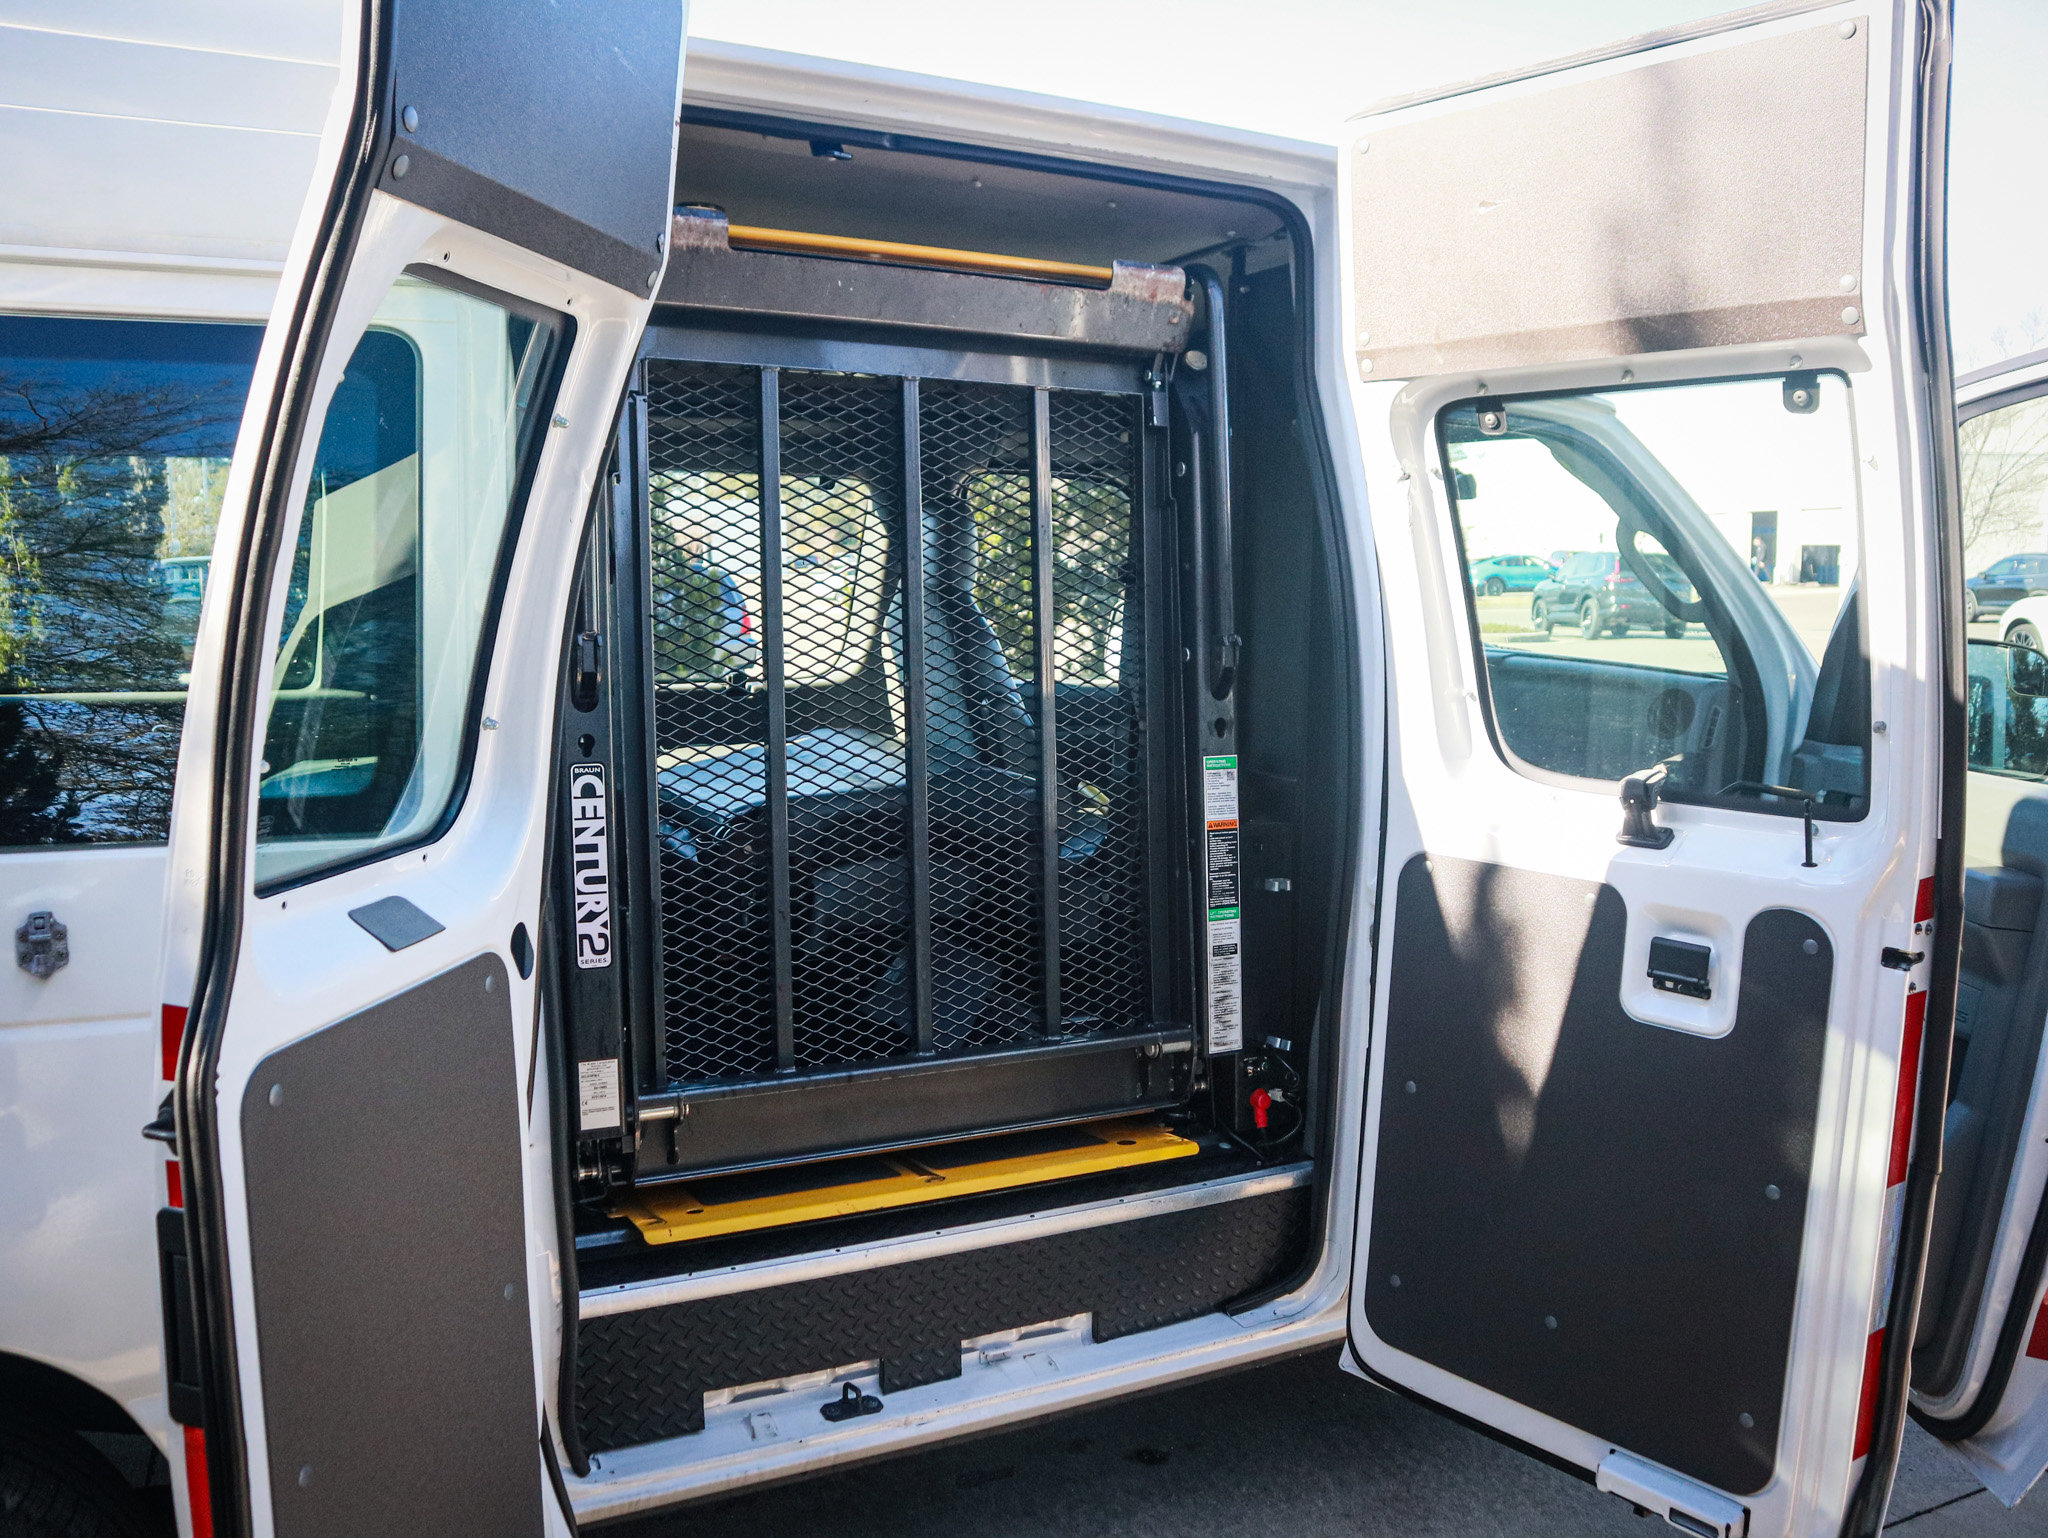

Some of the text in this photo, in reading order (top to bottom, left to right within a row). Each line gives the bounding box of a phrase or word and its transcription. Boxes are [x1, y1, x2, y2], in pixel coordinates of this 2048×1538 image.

[574, 766, 601, 774] BRAUN
[1213, 820, 1237, 828] WARNING
[580, 957, 607, 965] SERIES
